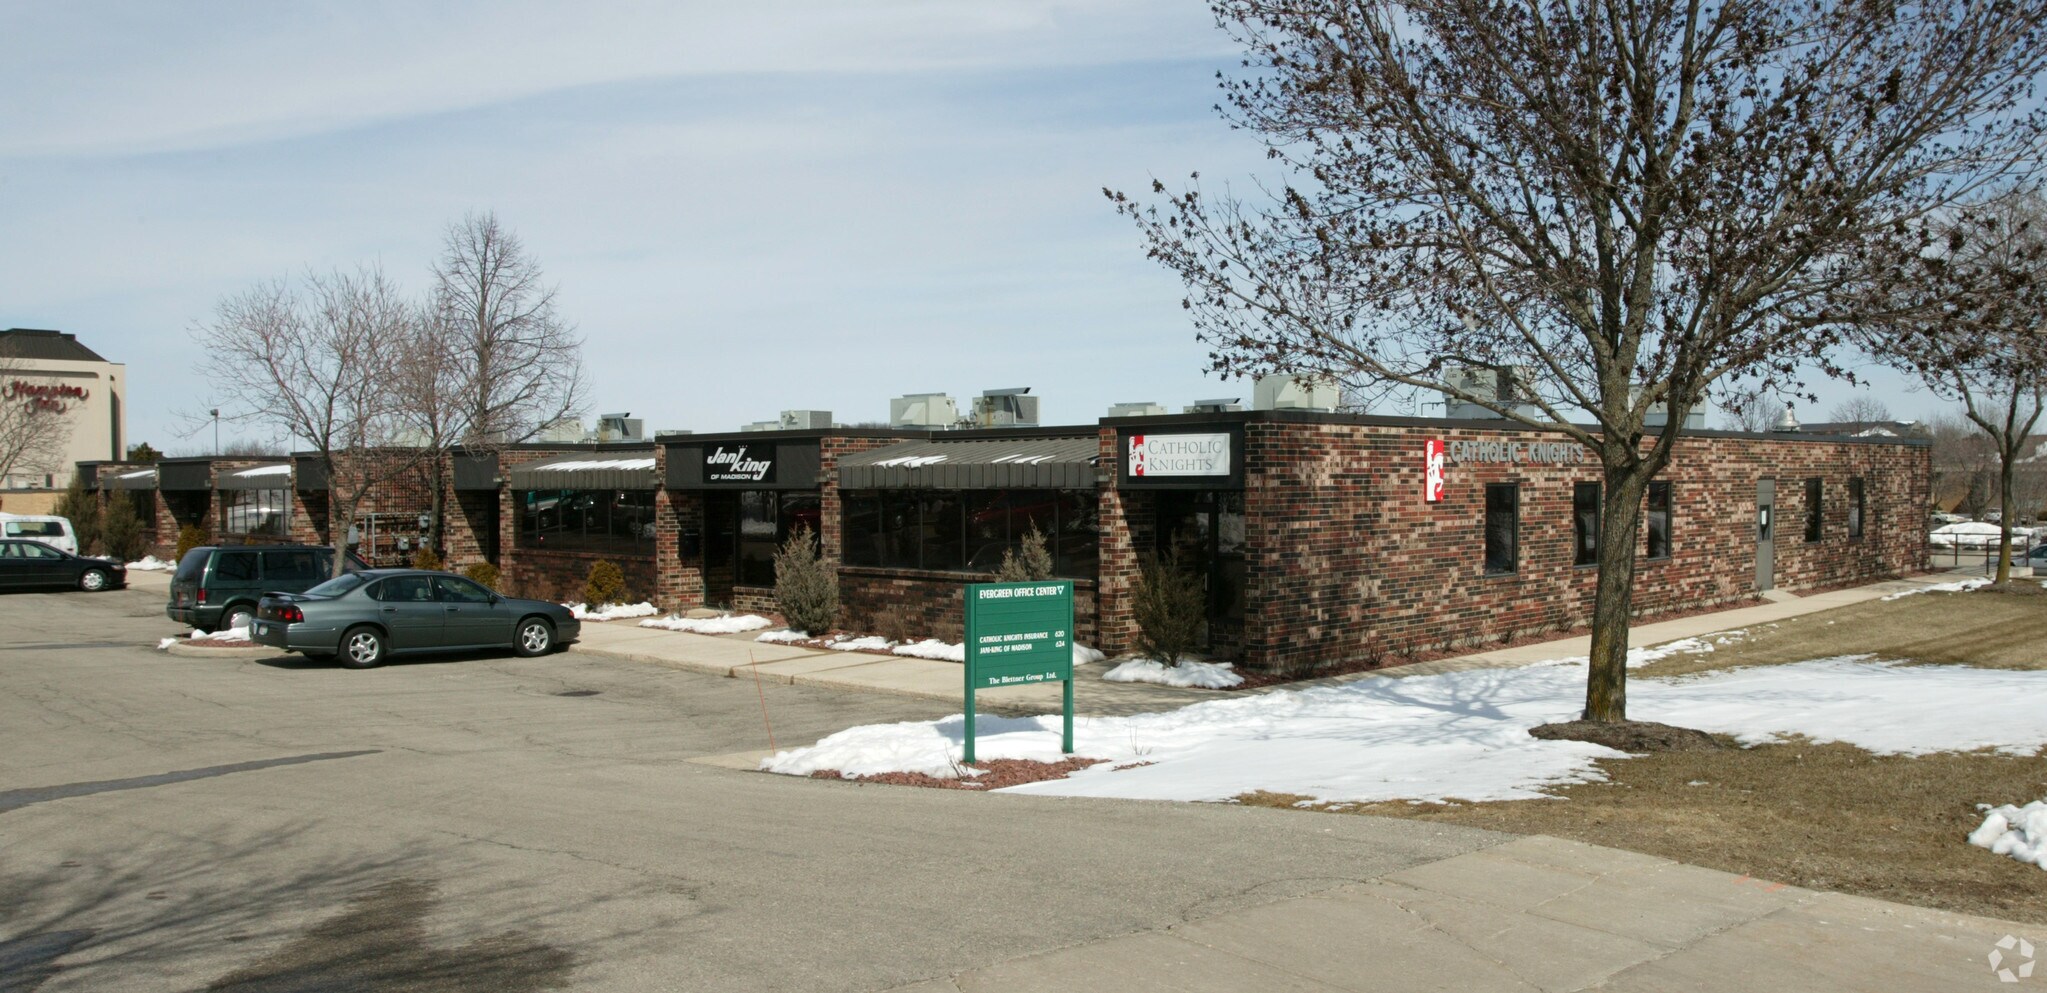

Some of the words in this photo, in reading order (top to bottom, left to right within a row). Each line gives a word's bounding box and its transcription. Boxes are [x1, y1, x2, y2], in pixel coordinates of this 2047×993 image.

[1450, 441, 1522, 463] CATHOLIC
[1529, 443, 1584, 464] KNIGHTS
[979, 588, 1013, 599] EVERGREEN
[1014, 587, 1034, 597] OFFICE
[1036, 586, 1057, 596] CENTER
[979, 634, 1002, 643] CATHOLIC
[1003, 633, 1023, 642] KNIGHTS
[1024, 632, 1048, 640] INSURANCE
[1055, 630, 1065, 638] 620
[1011, 643, 1032, 651] MADISON
[1026, 673, 1044, 681] Group
[1046, 671, 1057, 679] Ltd.
